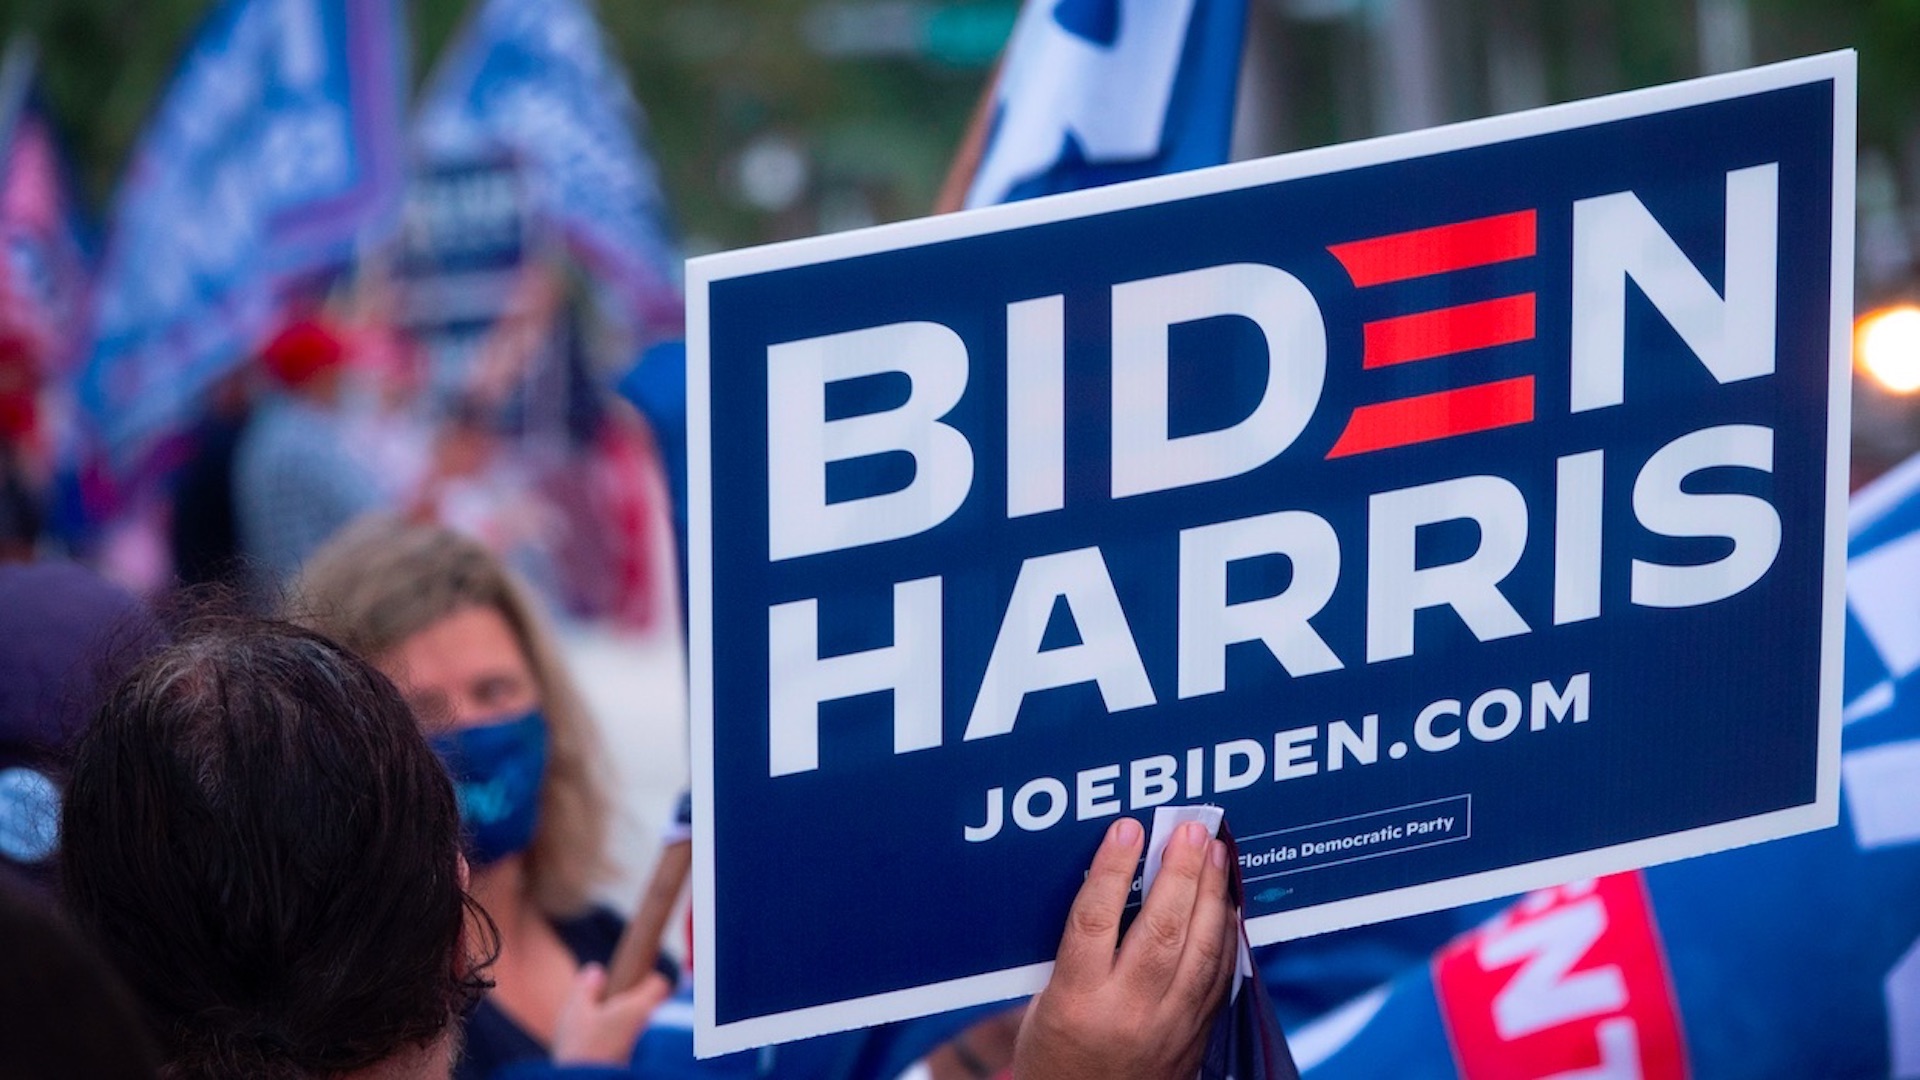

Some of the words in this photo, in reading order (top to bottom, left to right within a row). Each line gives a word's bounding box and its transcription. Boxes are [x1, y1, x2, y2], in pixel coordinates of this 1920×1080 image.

[768, 163, 1778, 561] BIDEN
[769, 425, 1781, 777] HARRIS
[965, 673, 1589, 841] JOEBIDEN.COM
[1301, 824, 1402, 858] Democratic
[1406, 816, 1455, 837] Party
